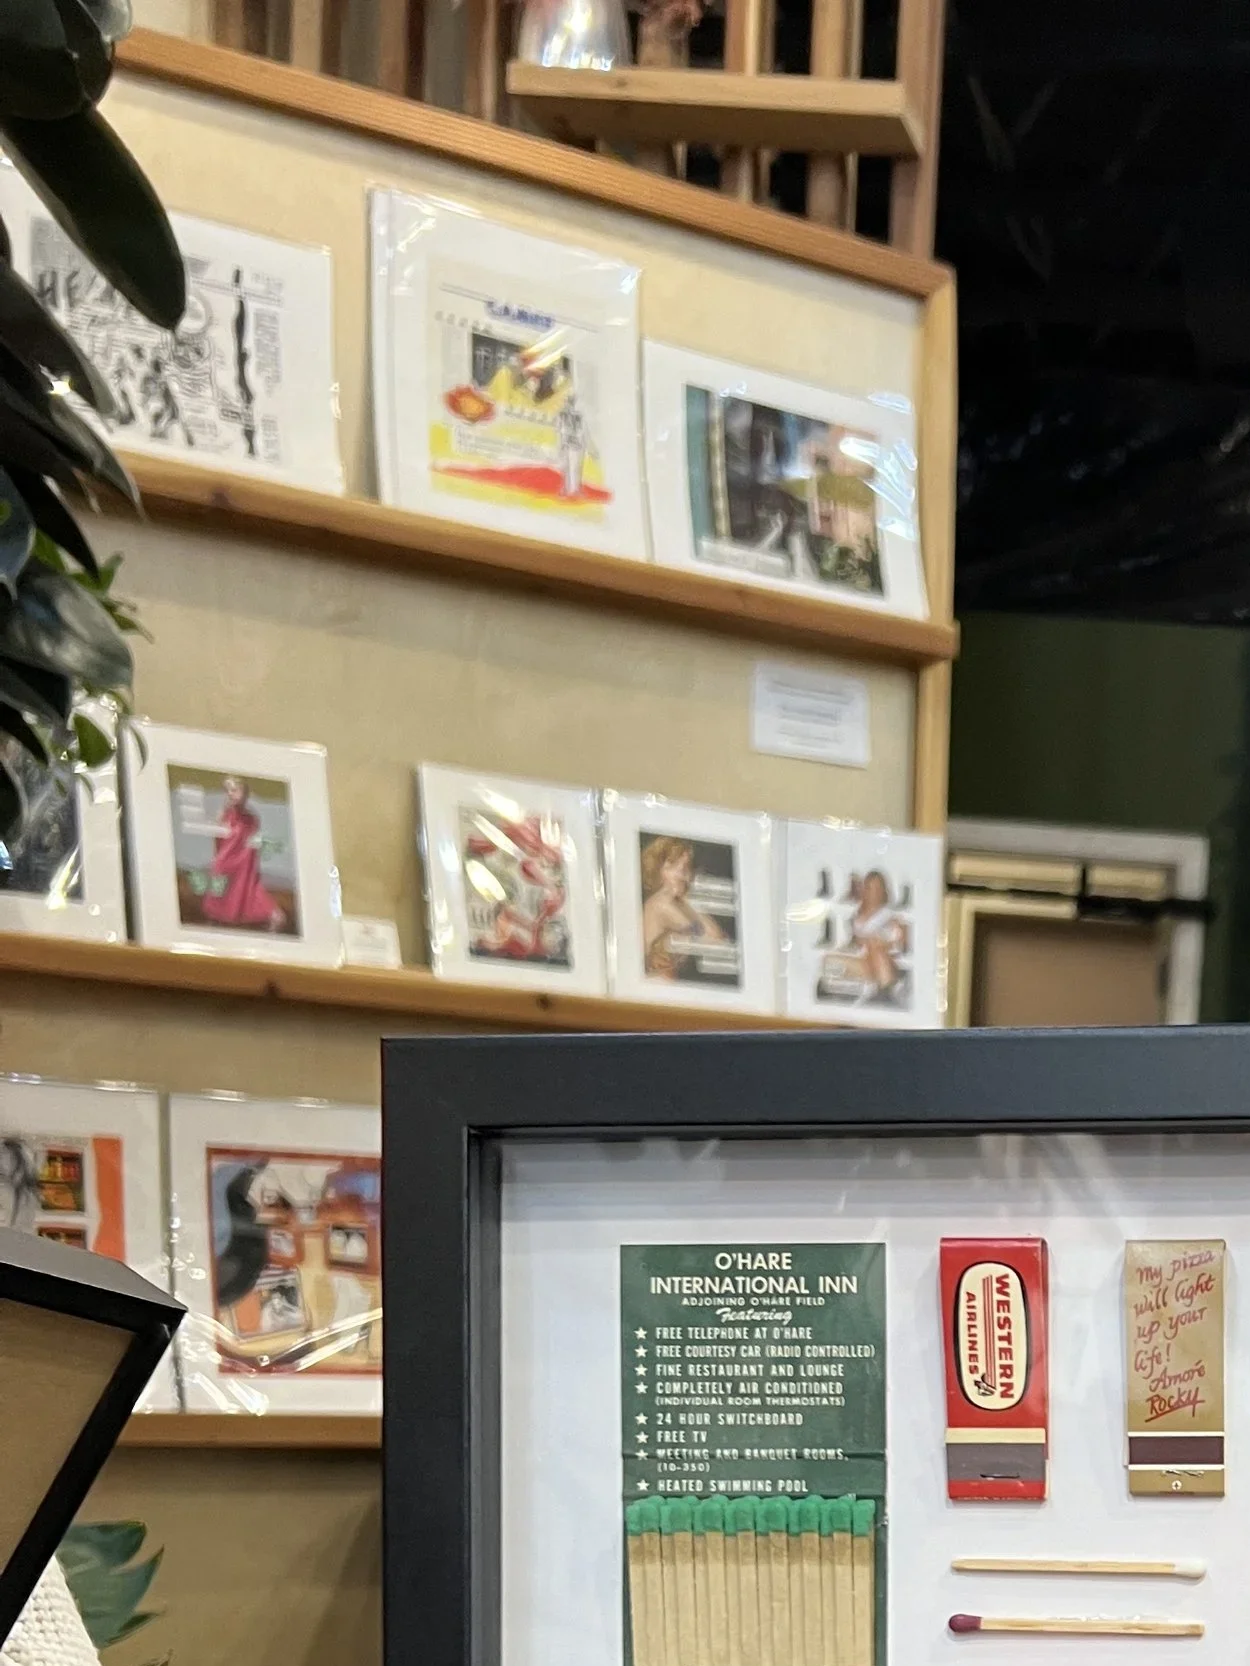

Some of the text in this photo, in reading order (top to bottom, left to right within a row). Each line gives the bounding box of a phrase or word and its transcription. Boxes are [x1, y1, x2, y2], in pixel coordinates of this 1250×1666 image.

[715, 1252, 792, 1270] O'HARE
[1169, 1250, 1216, 1282] pizza
[650, 1276, 858, 1294] INTERNATIONAL INN
[682, 1297, 745, 1306] ADJOINING
[796, 1297, 825, 1306] FIELD
[1134, 1272, 1216, 1317] will light
[715, 1307, 792, 1324] Featuring
[655, 1327, 813, 1339] FREE TELEPHONE AT O'HARE
[965, 1291, 980, 1375] AIRLINES
[1136, 1307, 1208, 1344] up your
[995, 1273, 1014, 1399] WESTERN
[655, 1345, 875, 1358] FREE COURTESY CAR (RADIO CONTROLLED)
[1134, 1344, 1171, 1379] life!
[655, 1364, 844, 1377] FINE RESTAURANT AND LOUNGE
[656, 1382, 843, 1394] COMPLETELY AIR CONDITIONED
[655, 1396, 845, 1407] (INDIVIDUAL ROOM THERMOSTATS)
[656, 1413, 803, 1425] 24 HOUR SWITCHBOARD
[657, 1430, 708, 1443] FREE TV
[658, 1480, 808, 1492] HEATED SWIMMING POOL
